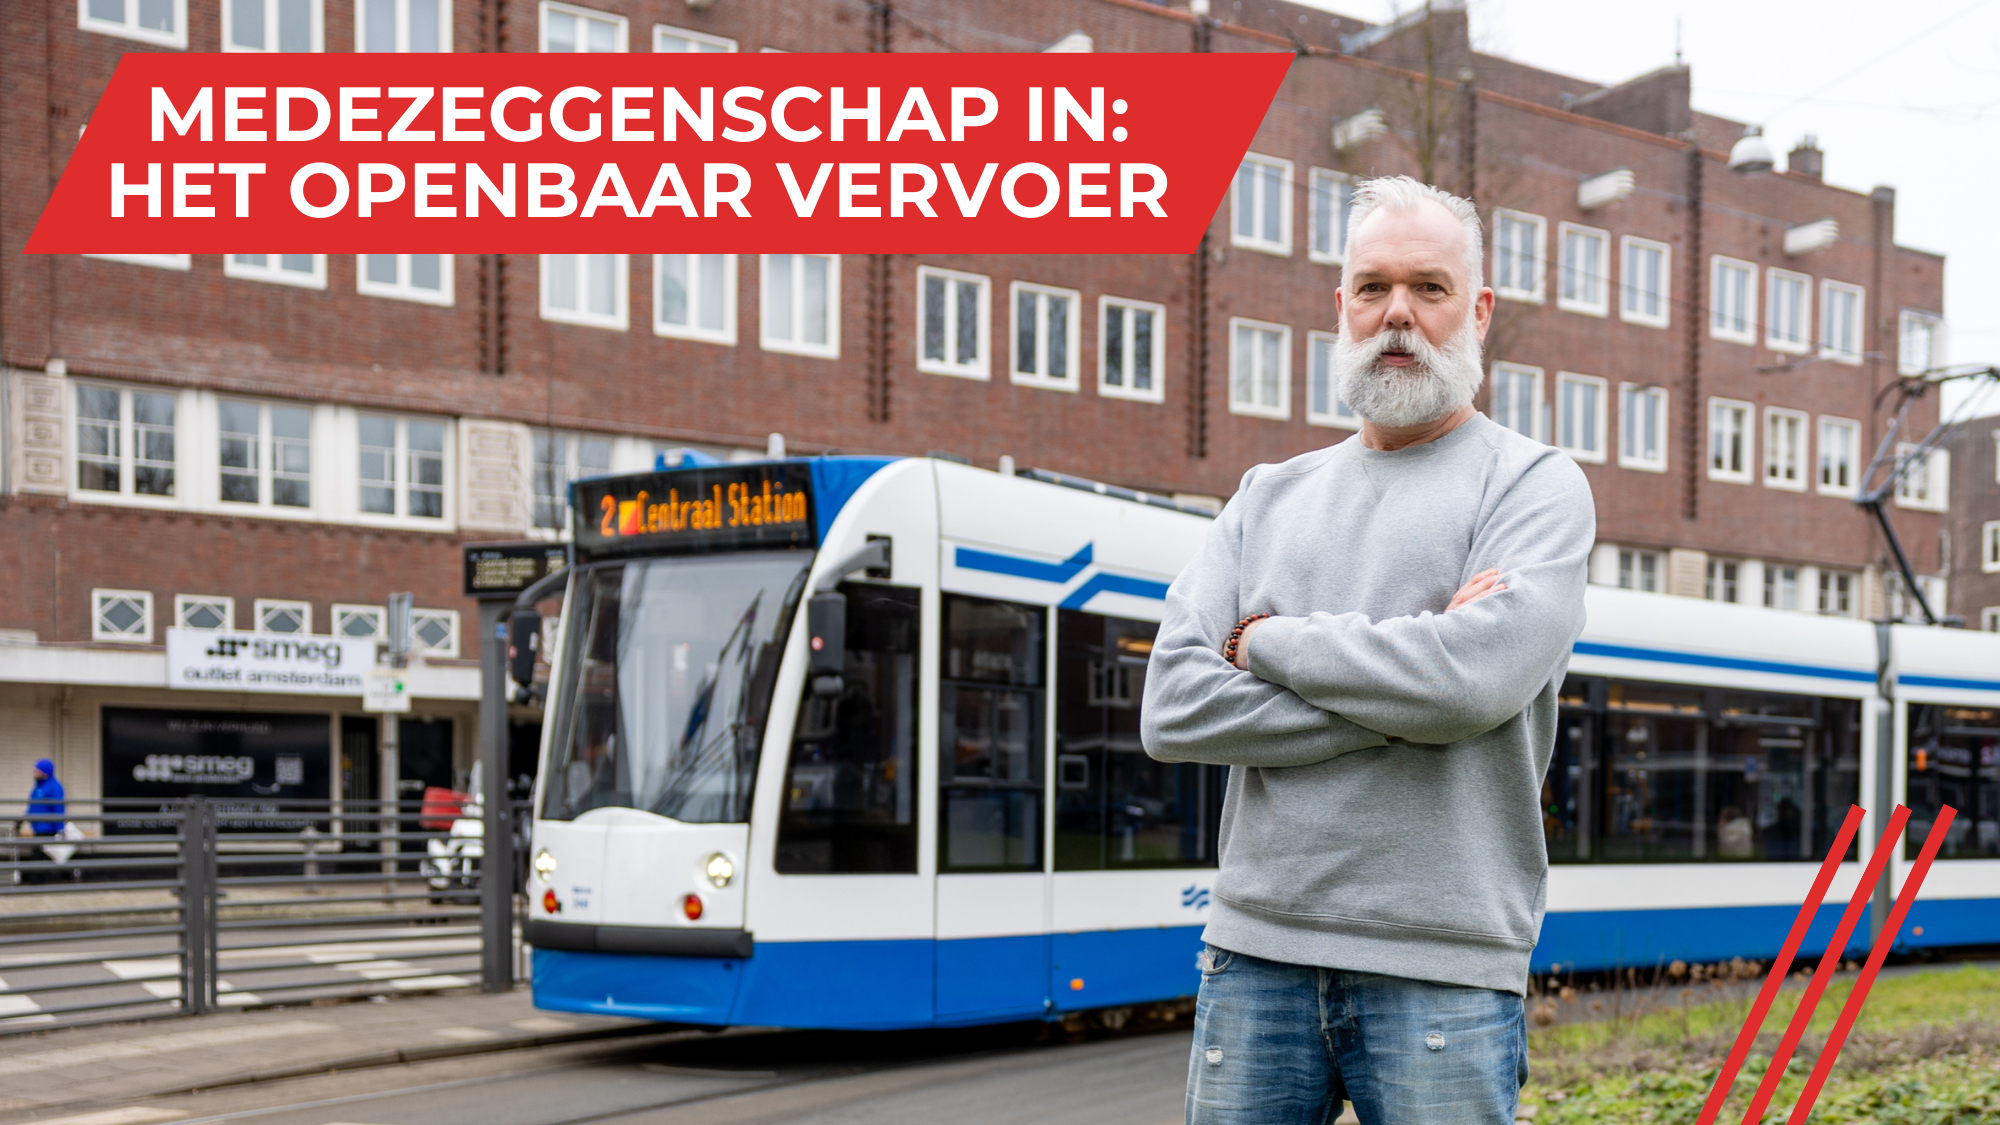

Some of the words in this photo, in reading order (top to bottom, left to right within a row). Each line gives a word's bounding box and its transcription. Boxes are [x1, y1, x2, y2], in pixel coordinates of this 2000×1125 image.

[600, 494, 616, 536] 2
[636, 483, 723, 535] Centraal
[727, 479, 807, 527] Station
[252, 637, 342, 667] smeg
[183, 665, 242, 682] outlet
[246, 670, 362, 687] amsterdam
[184, 755, 254, 780] smeg
